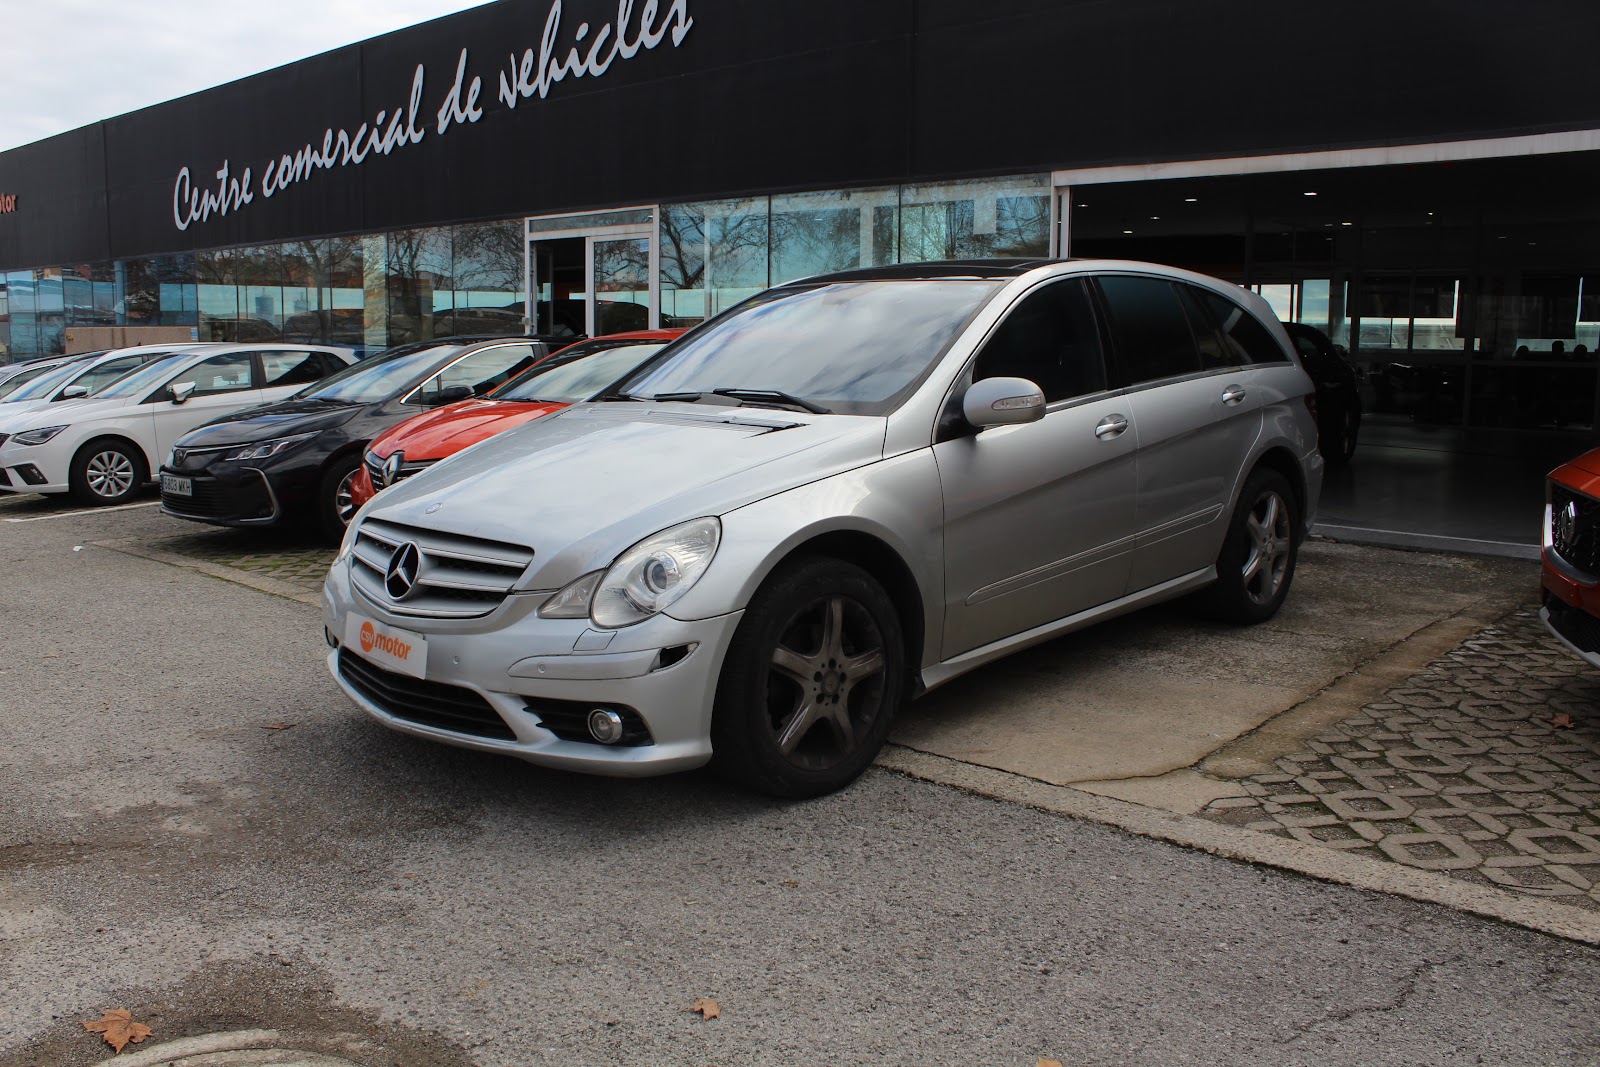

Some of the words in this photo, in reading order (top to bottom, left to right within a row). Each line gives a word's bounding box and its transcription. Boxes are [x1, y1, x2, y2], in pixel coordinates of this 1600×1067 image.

[173, 159, 254, 231] Centre
[262, 63, 425, 198] comercial
[437, 47, 483, 135] de
[499, 0, 693, 108] vehicles
[375, 632, 411, 660] motor
